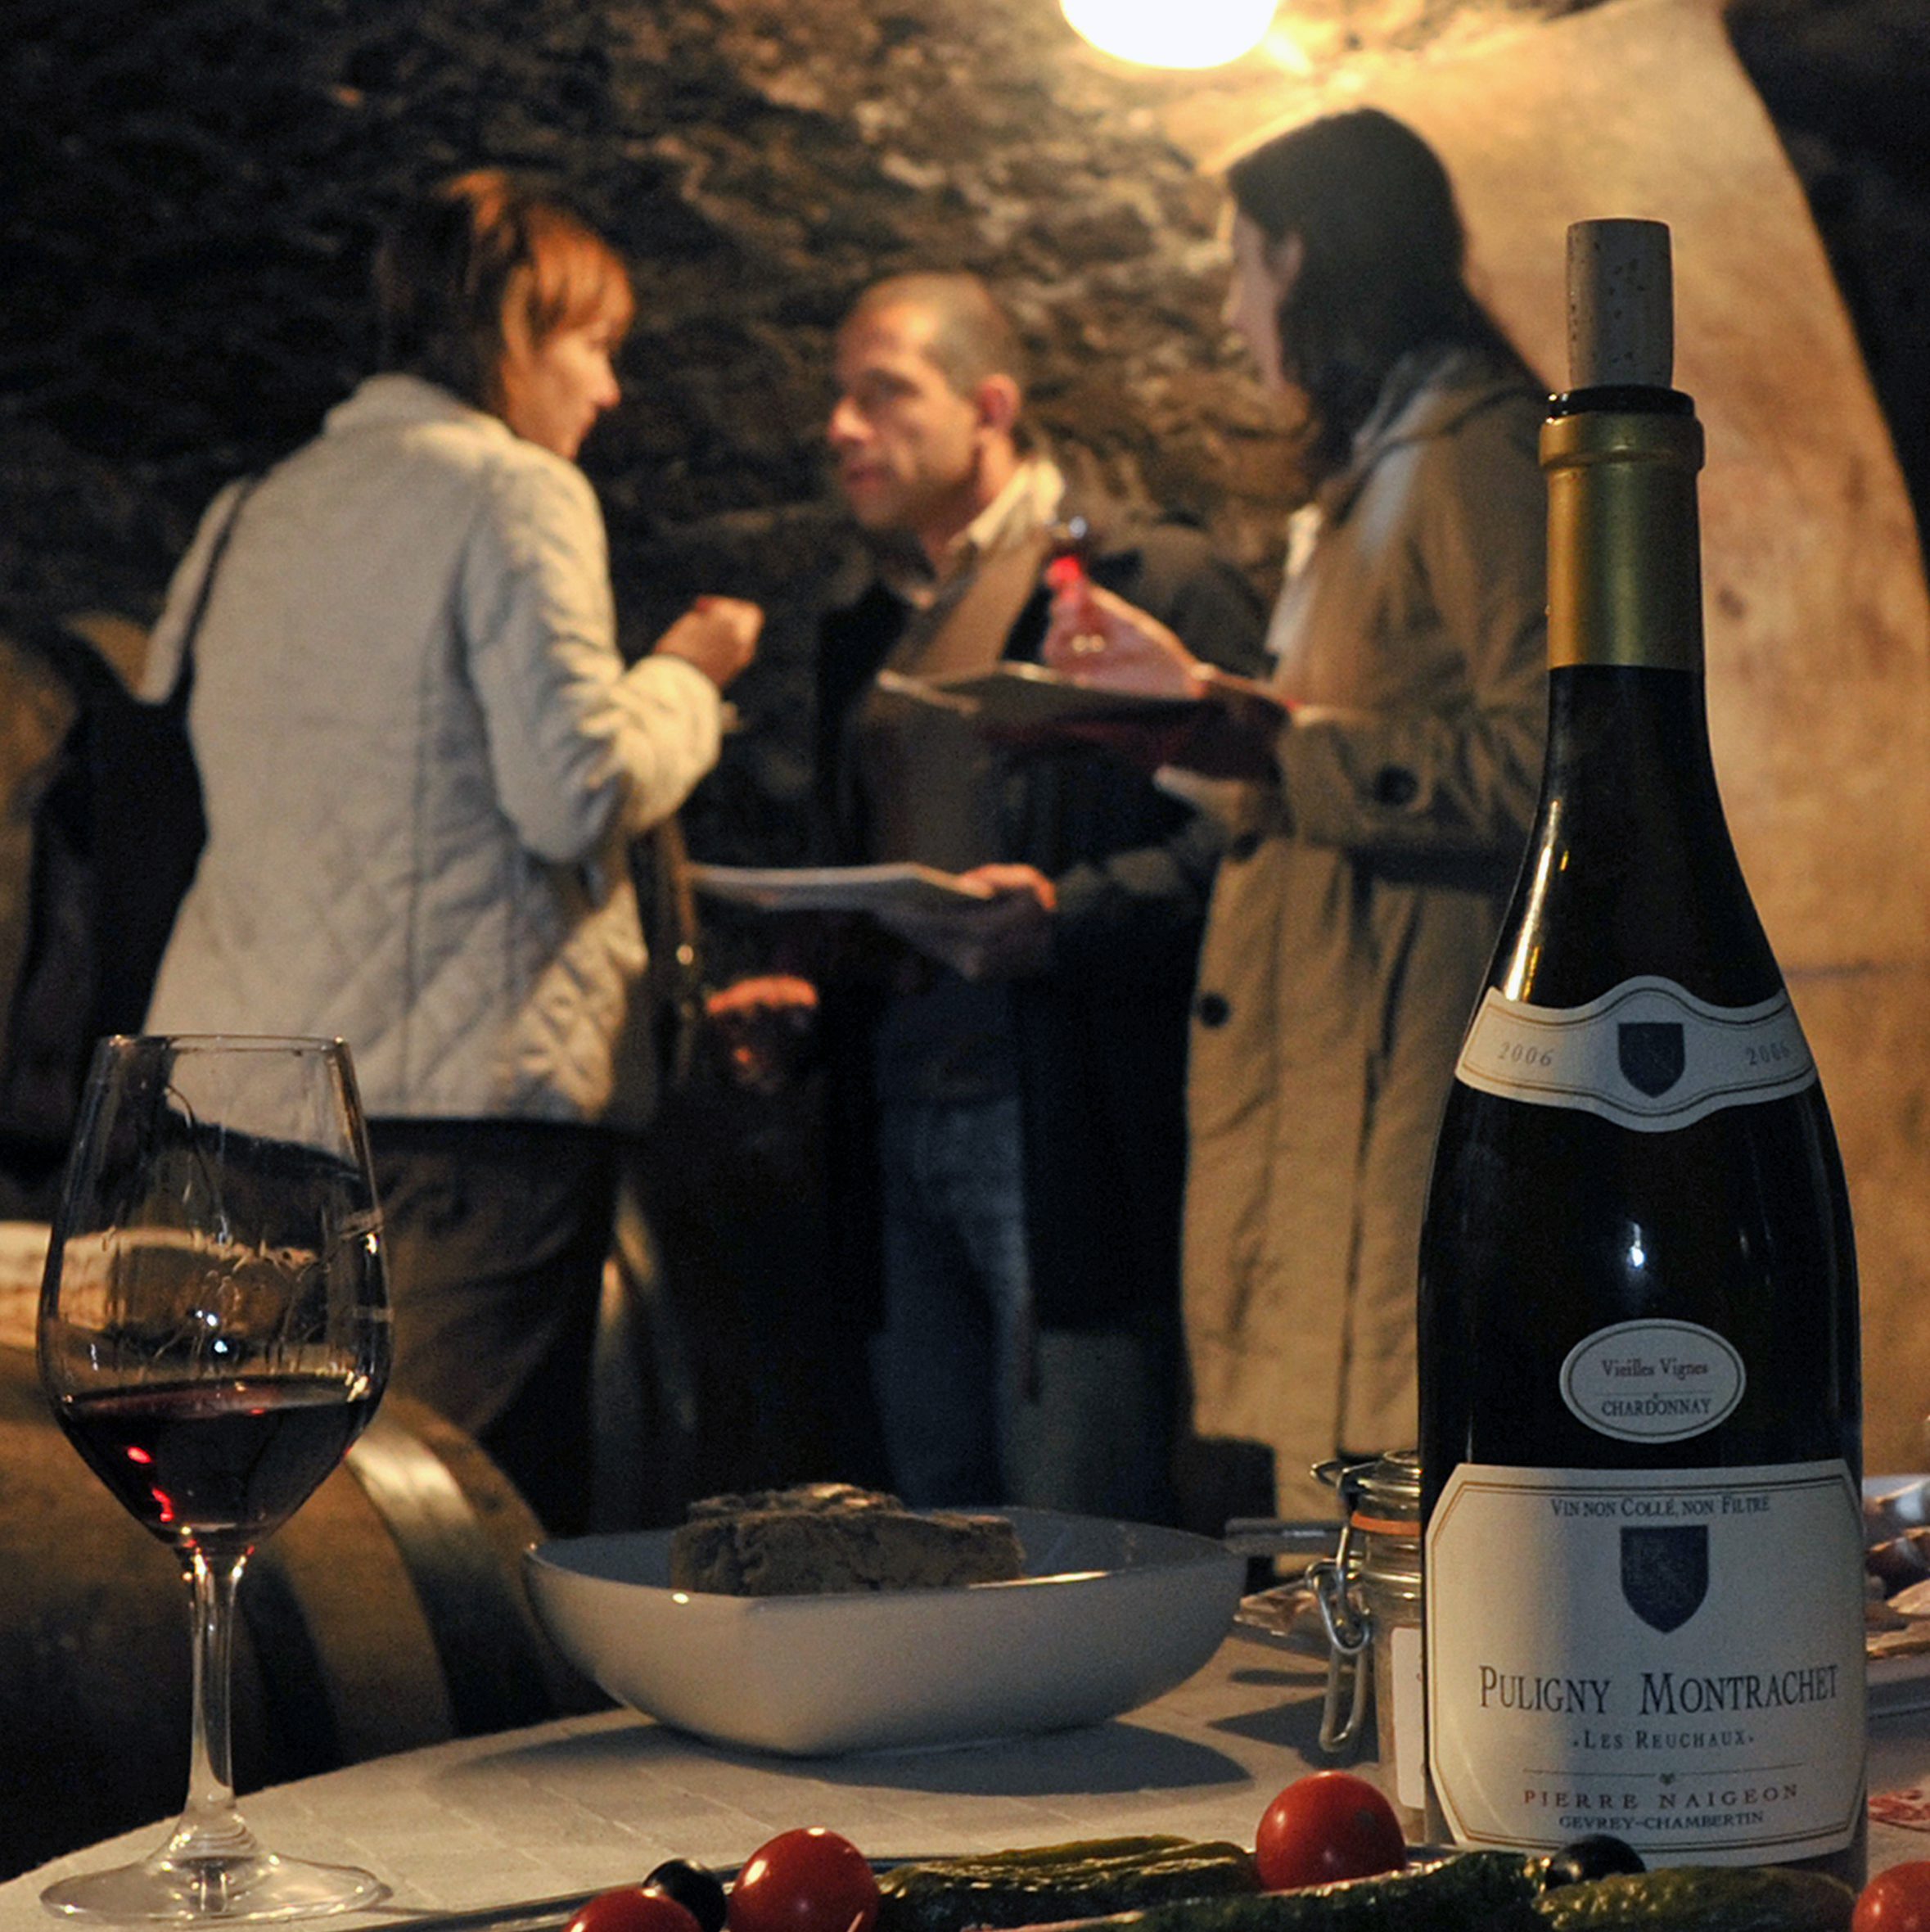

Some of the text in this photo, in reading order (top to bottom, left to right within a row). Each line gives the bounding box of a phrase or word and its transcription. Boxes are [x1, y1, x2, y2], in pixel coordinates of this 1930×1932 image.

[1498, 1040, 1553, 1067] 2006
[1602, 1357, 1708, 1380] Vieilles Vignes
[1601, 1398, 1711, 1417] CHARDONNAY
[1480, 1664, 1838, 1716] PULIGNY MONTRACHET
[1523, 1784, 1798, 1809] PIERRE NAIGEON
[1559, 1811, 1764, 1830] GEVREY-CHAMBERTIN
